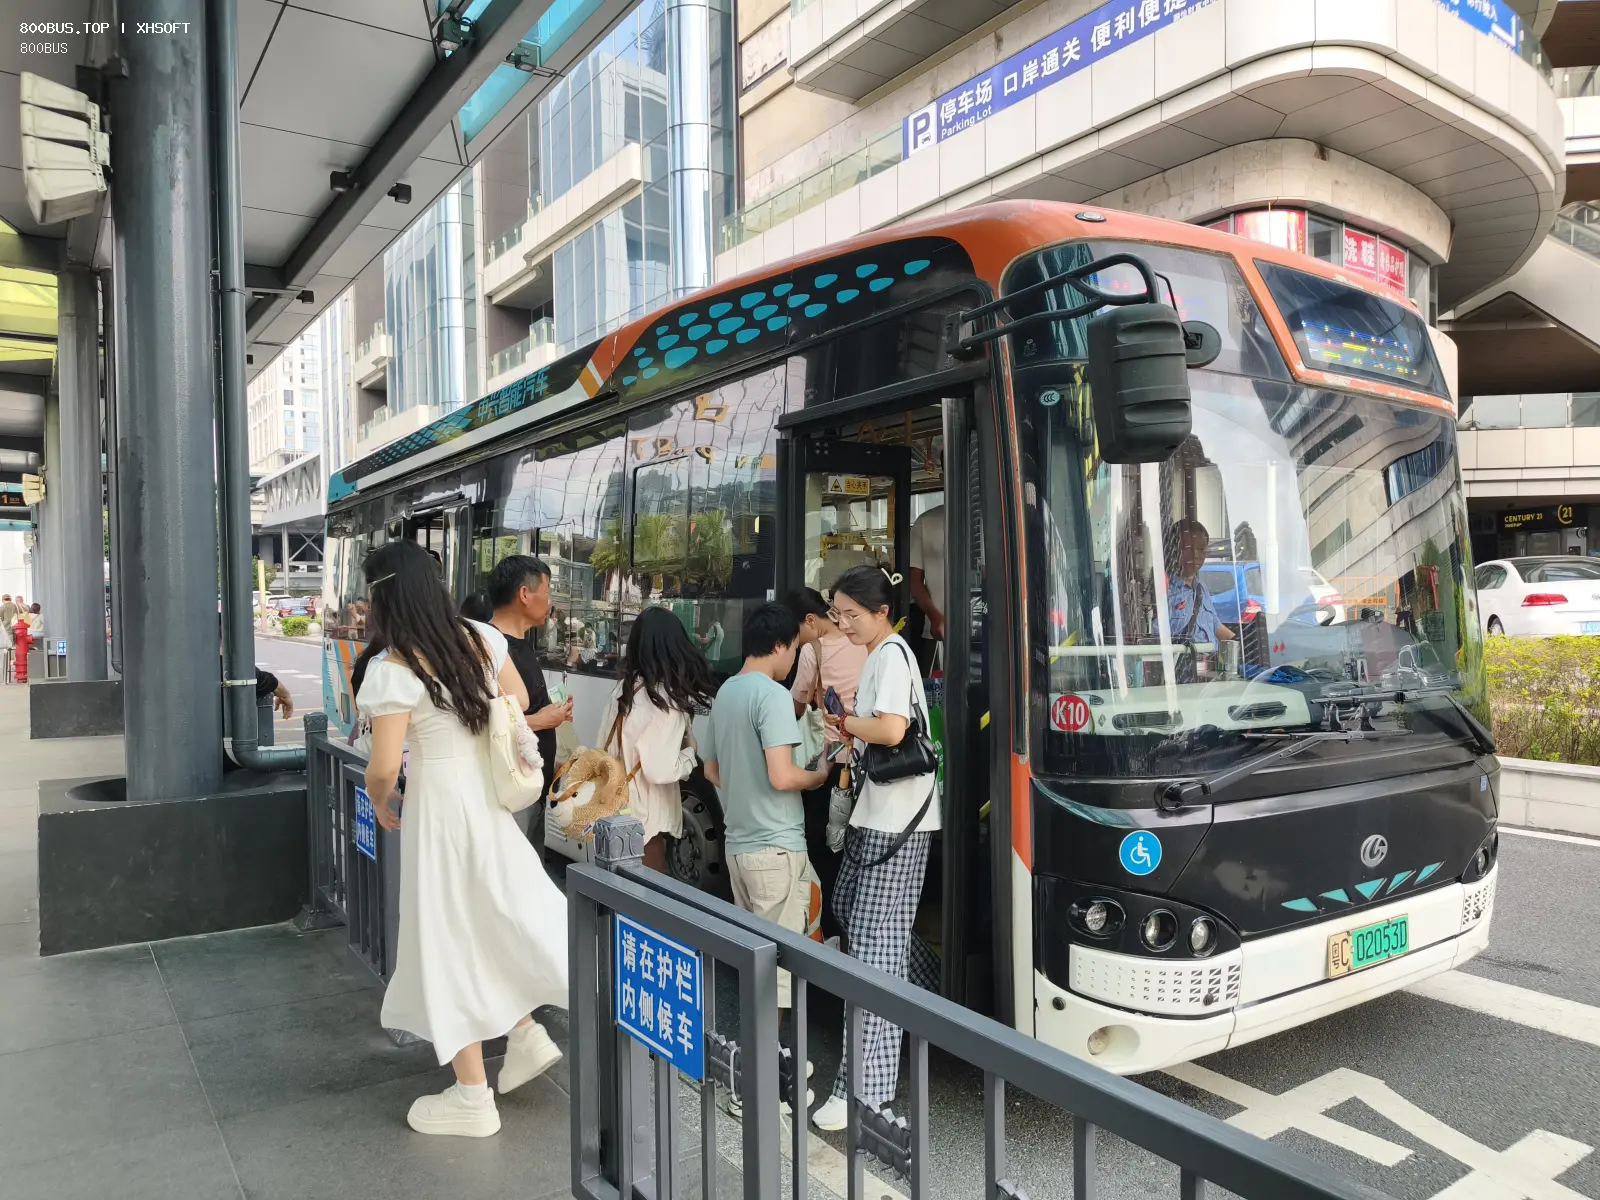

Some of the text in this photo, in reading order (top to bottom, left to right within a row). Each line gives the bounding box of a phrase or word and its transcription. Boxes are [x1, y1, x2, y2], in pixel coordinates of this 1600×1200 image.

[939, 78, 993, 127] 停车场
[1003, 36, 1081, 97] 口岸通关
[941, 104, 992, 139] Parking Lot
[1504, 513, 1535, 523] CENTURY
[1055, 700, 1085, 726] K10
[621, 929, 694, 1004] 请在护栏
[1331, 938, 1350, 969] 粤C
[621, 978, 694, 1056] 内侧候车
